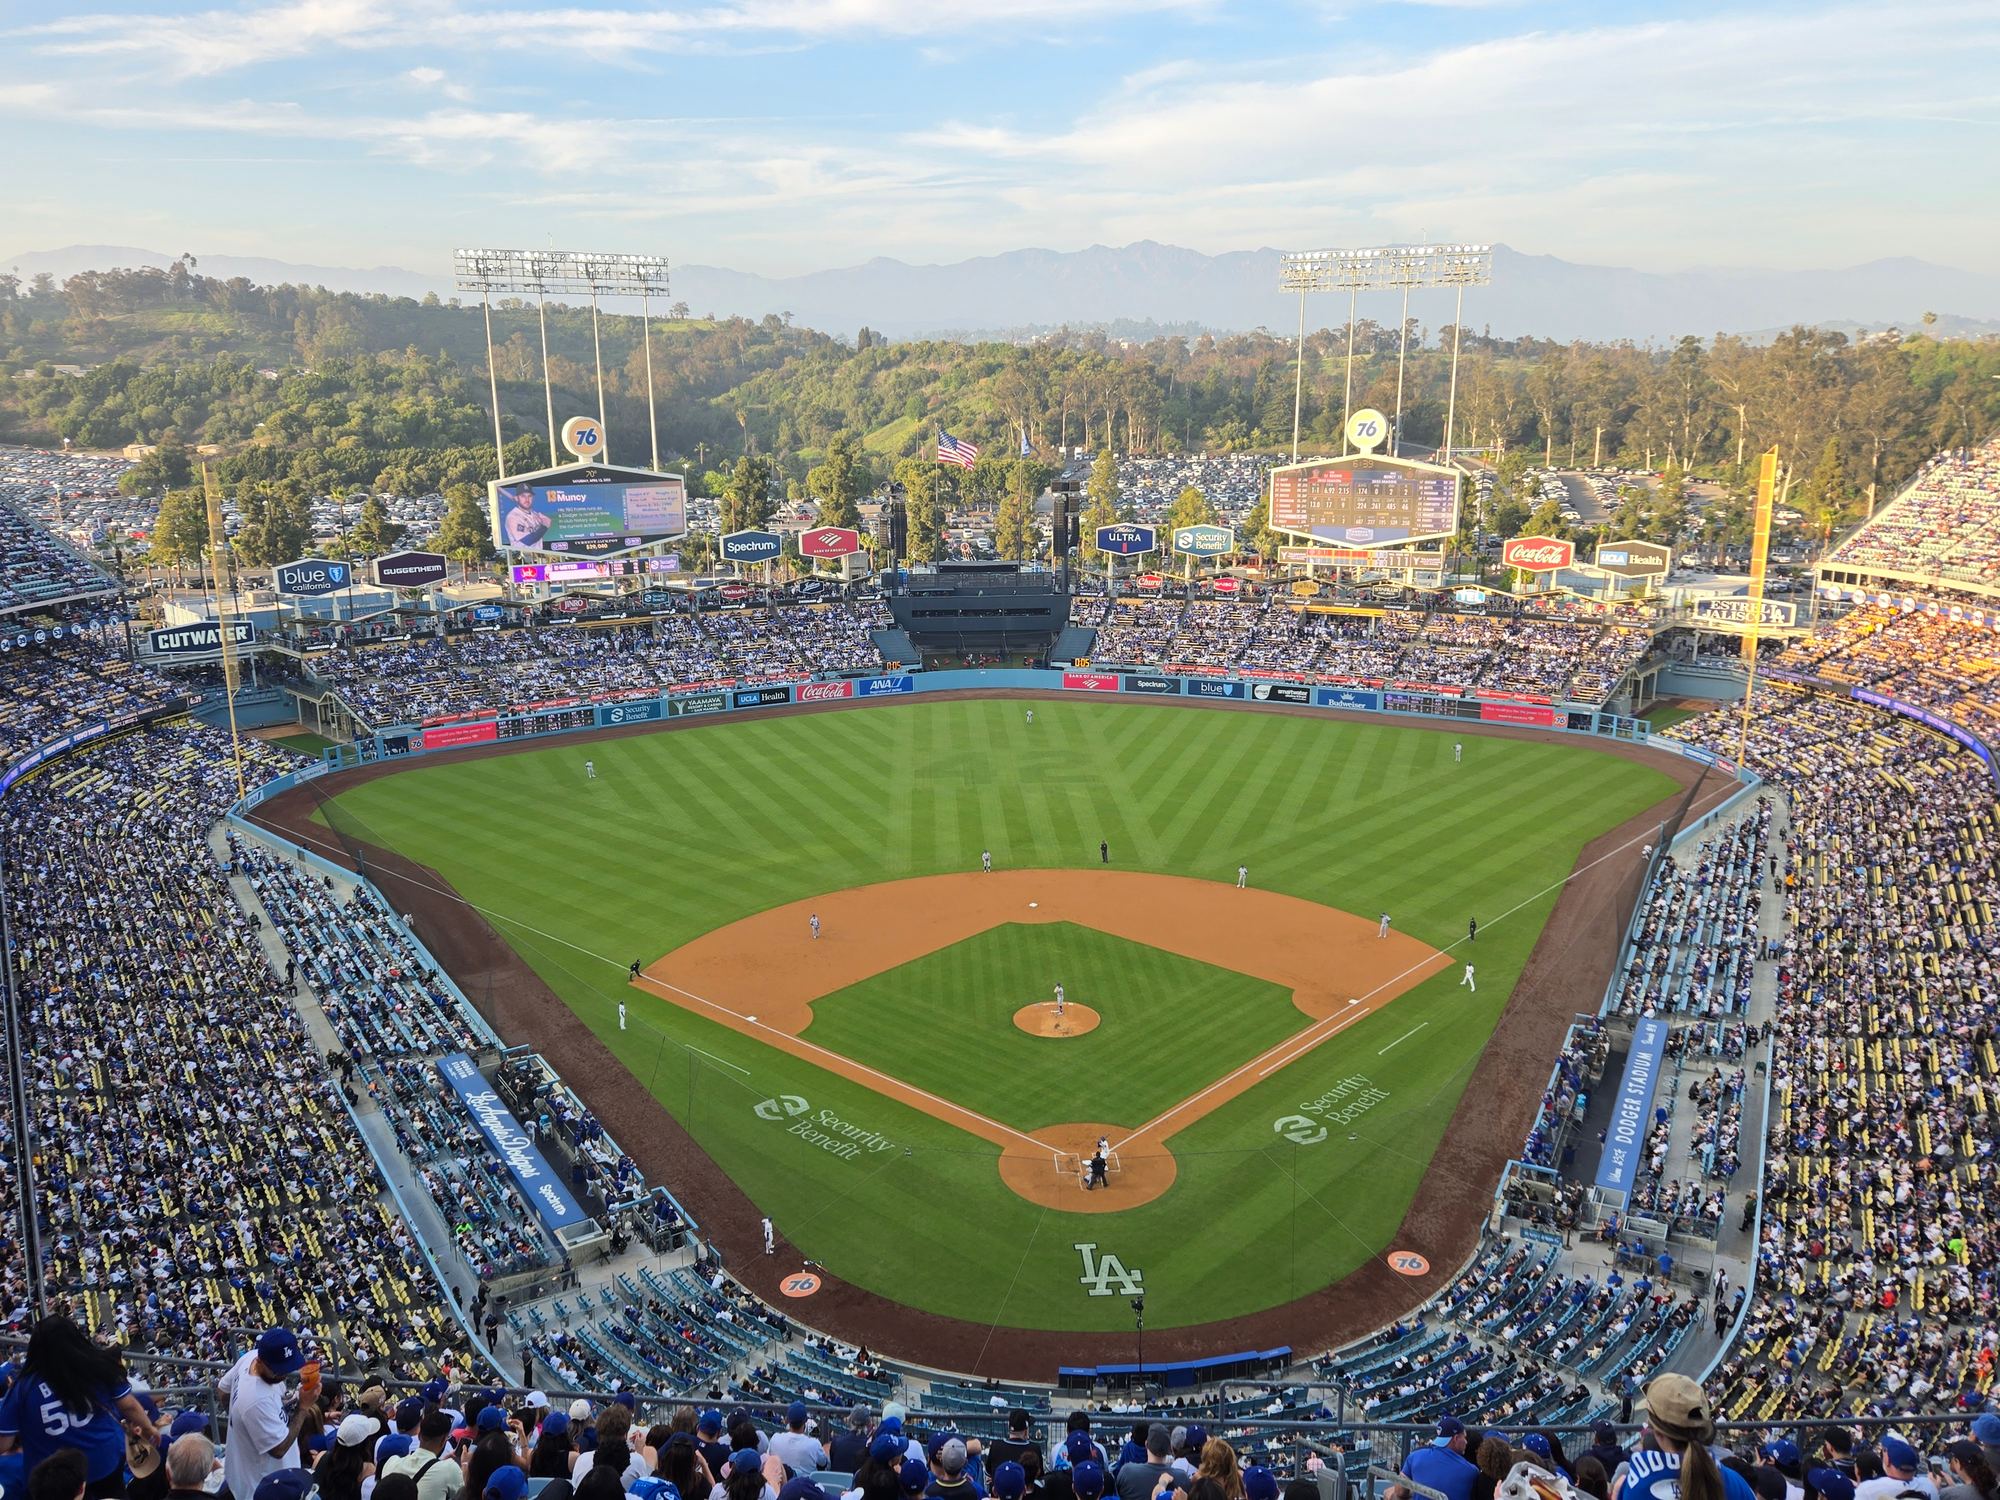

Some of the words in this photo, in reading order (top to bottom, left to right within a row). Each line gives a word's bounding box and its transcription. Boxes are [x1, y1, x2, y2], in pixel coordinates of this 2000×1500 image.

[1356, 421, 1378, 437] 76
[575, 428, 598, 446] 76
[557, 494, 587, 502] Muncy
[1108, 534, 1142, 542] ULTRA
[1196, 532, 1228, 543] Security
[728, 541, 774, 554] Spectrum
[1196, 542, 1223, 550] Benefit
[1508, 544, 1566, 564] Coca-Cola
[1629, 554, 1663, 566] Health
[383, 564, 442, 576] GUGGENHEIM
[283, 568, 326, 585] blue
[292, 582, 331, 592] california
[565, 600, 583, 610] JINRO
[870, 680, 892, 690] ANA
[1138, 680, 1167, 689] Spectrum
[1200, 682, 1222, 692] blue
[762, 692, 786, 701] Health
[802, 682, 845, 700] Coca-Cola
[624, 704, 650, 715] Security
[1328, 699, 1366, 708] Budweiser
[624, 711, 648, 720] Benefit
[1555, 716, 1566, 724] 76
[411, 739, 422, 748] 76
[1627, 1051, 1653, 1095] STADIUM
[1300, 1073, 1373, 1115] Security
[1325, 1087, 1390, 1126] Benefit
[1615, 1097, 1642, 1145] DODGER
[810, 1109, 895, 1153] Security
[786, 1119, 862, 1161] Benefit
[501, 1136, 540, 1179] Dodgers
[538, 1183, 564, 1214] Spectrum
[1396, 1256, 1424, 1270] 76
[1074, 1243, 1145, 1297] LA
[787, 1276, 815, 1293] 76
